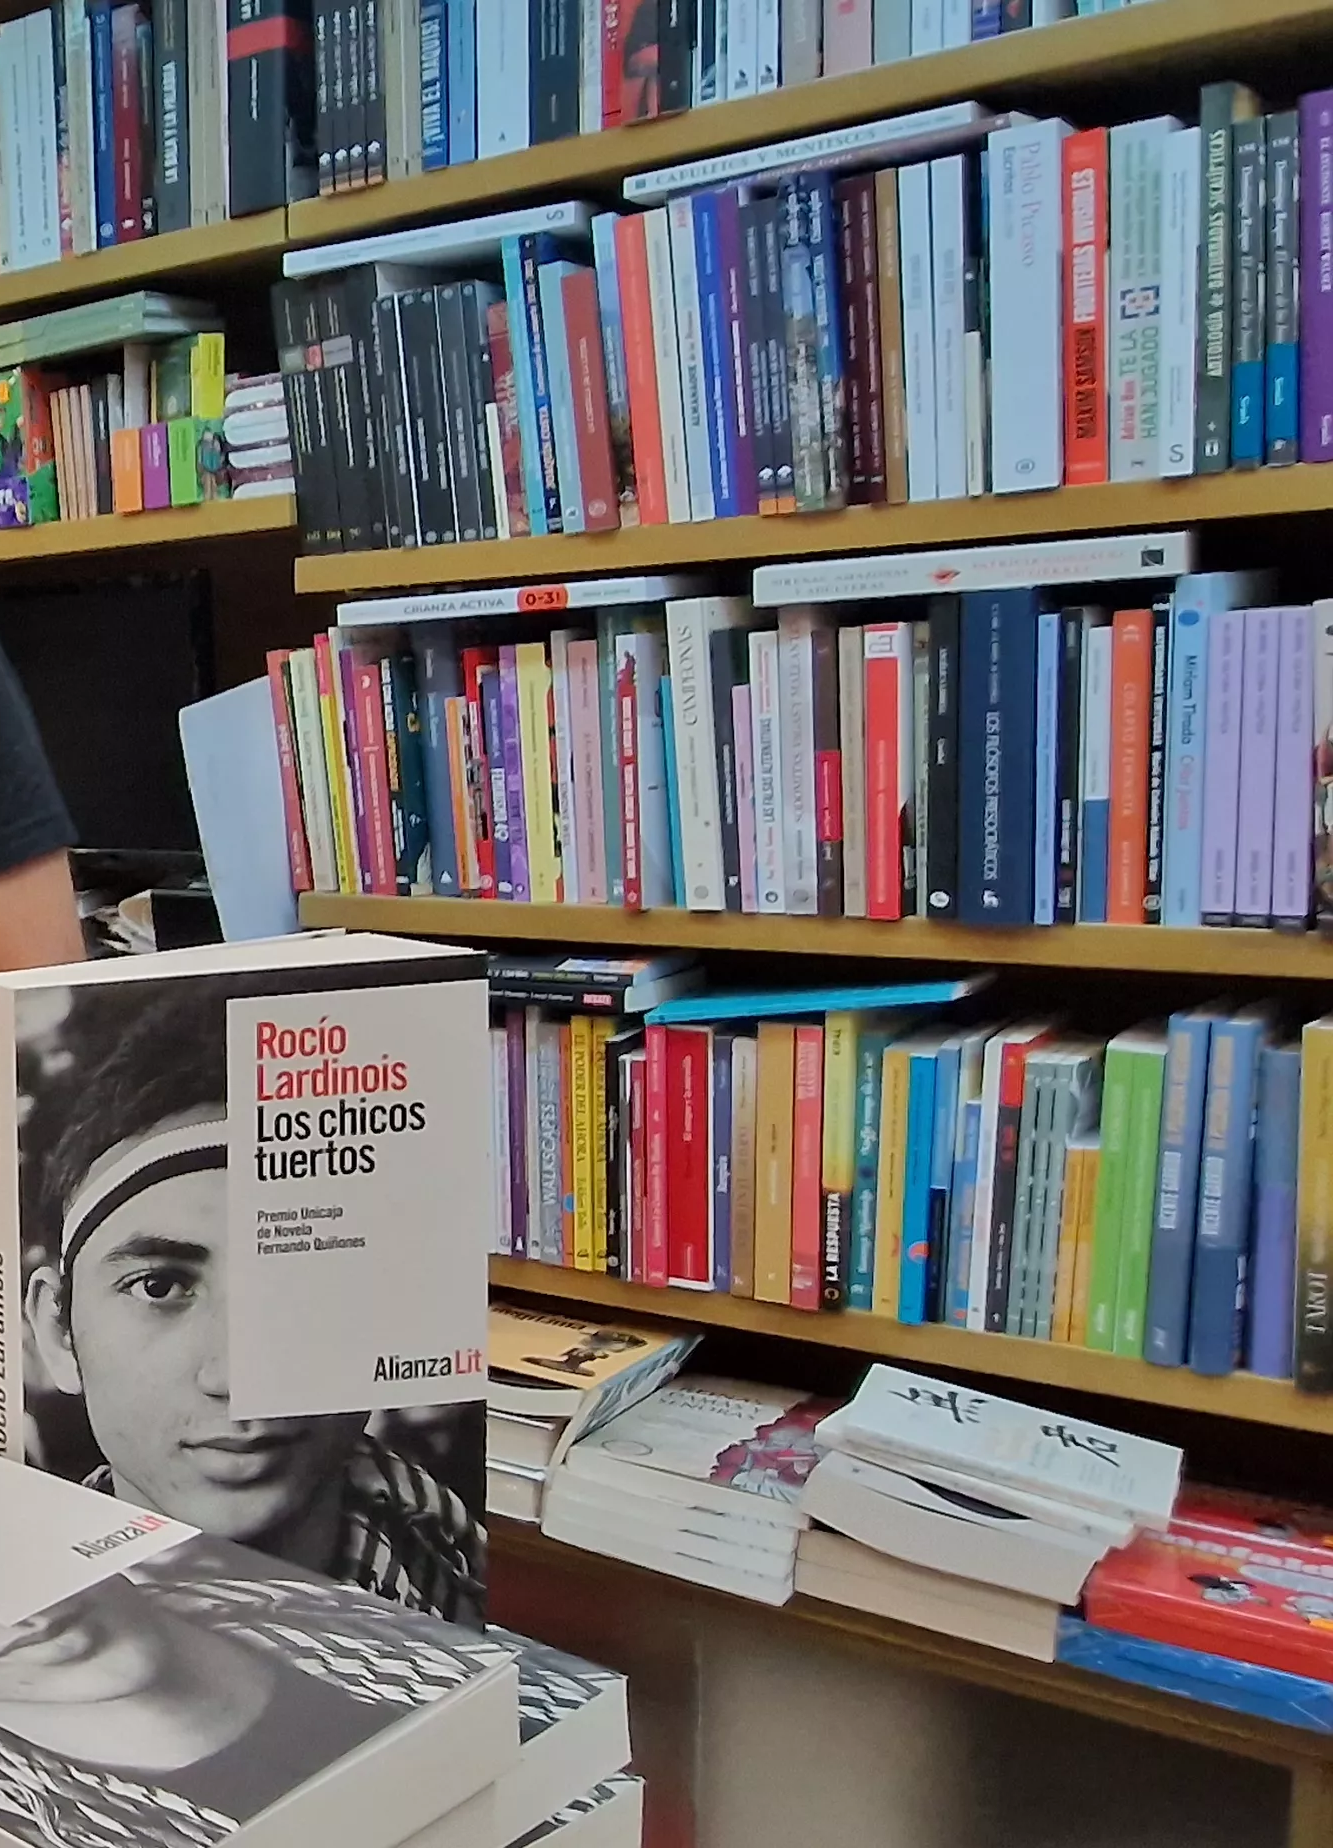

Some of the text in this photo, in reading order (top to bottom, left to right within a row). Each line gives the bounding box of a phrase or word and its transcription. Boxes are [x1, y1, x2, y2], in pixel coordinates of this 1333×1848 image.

[459, 597, 505, 611] ACTIVA
[256, 1014, 346, 1061] Rocío
[256, 1052, 407, 1101] Lardinois
[257, 1093, 425, 1143] Los chicos
[254, 1138, 375, 1181] tuertos
[540, 1103, 558, 1206] WALKSCAPES
[257, 1205, 343, 1223] Premio Unicaja
[257, 1223, 311, 1239] de Novela
[257, 1234, 365, 1255] Fernando Quiñones
[826, 1264, 841, 1281] LA
[374, 1348, 482, 1381] Alianza Lit
[71, 1513, 170, 1560] Alianza Lit
